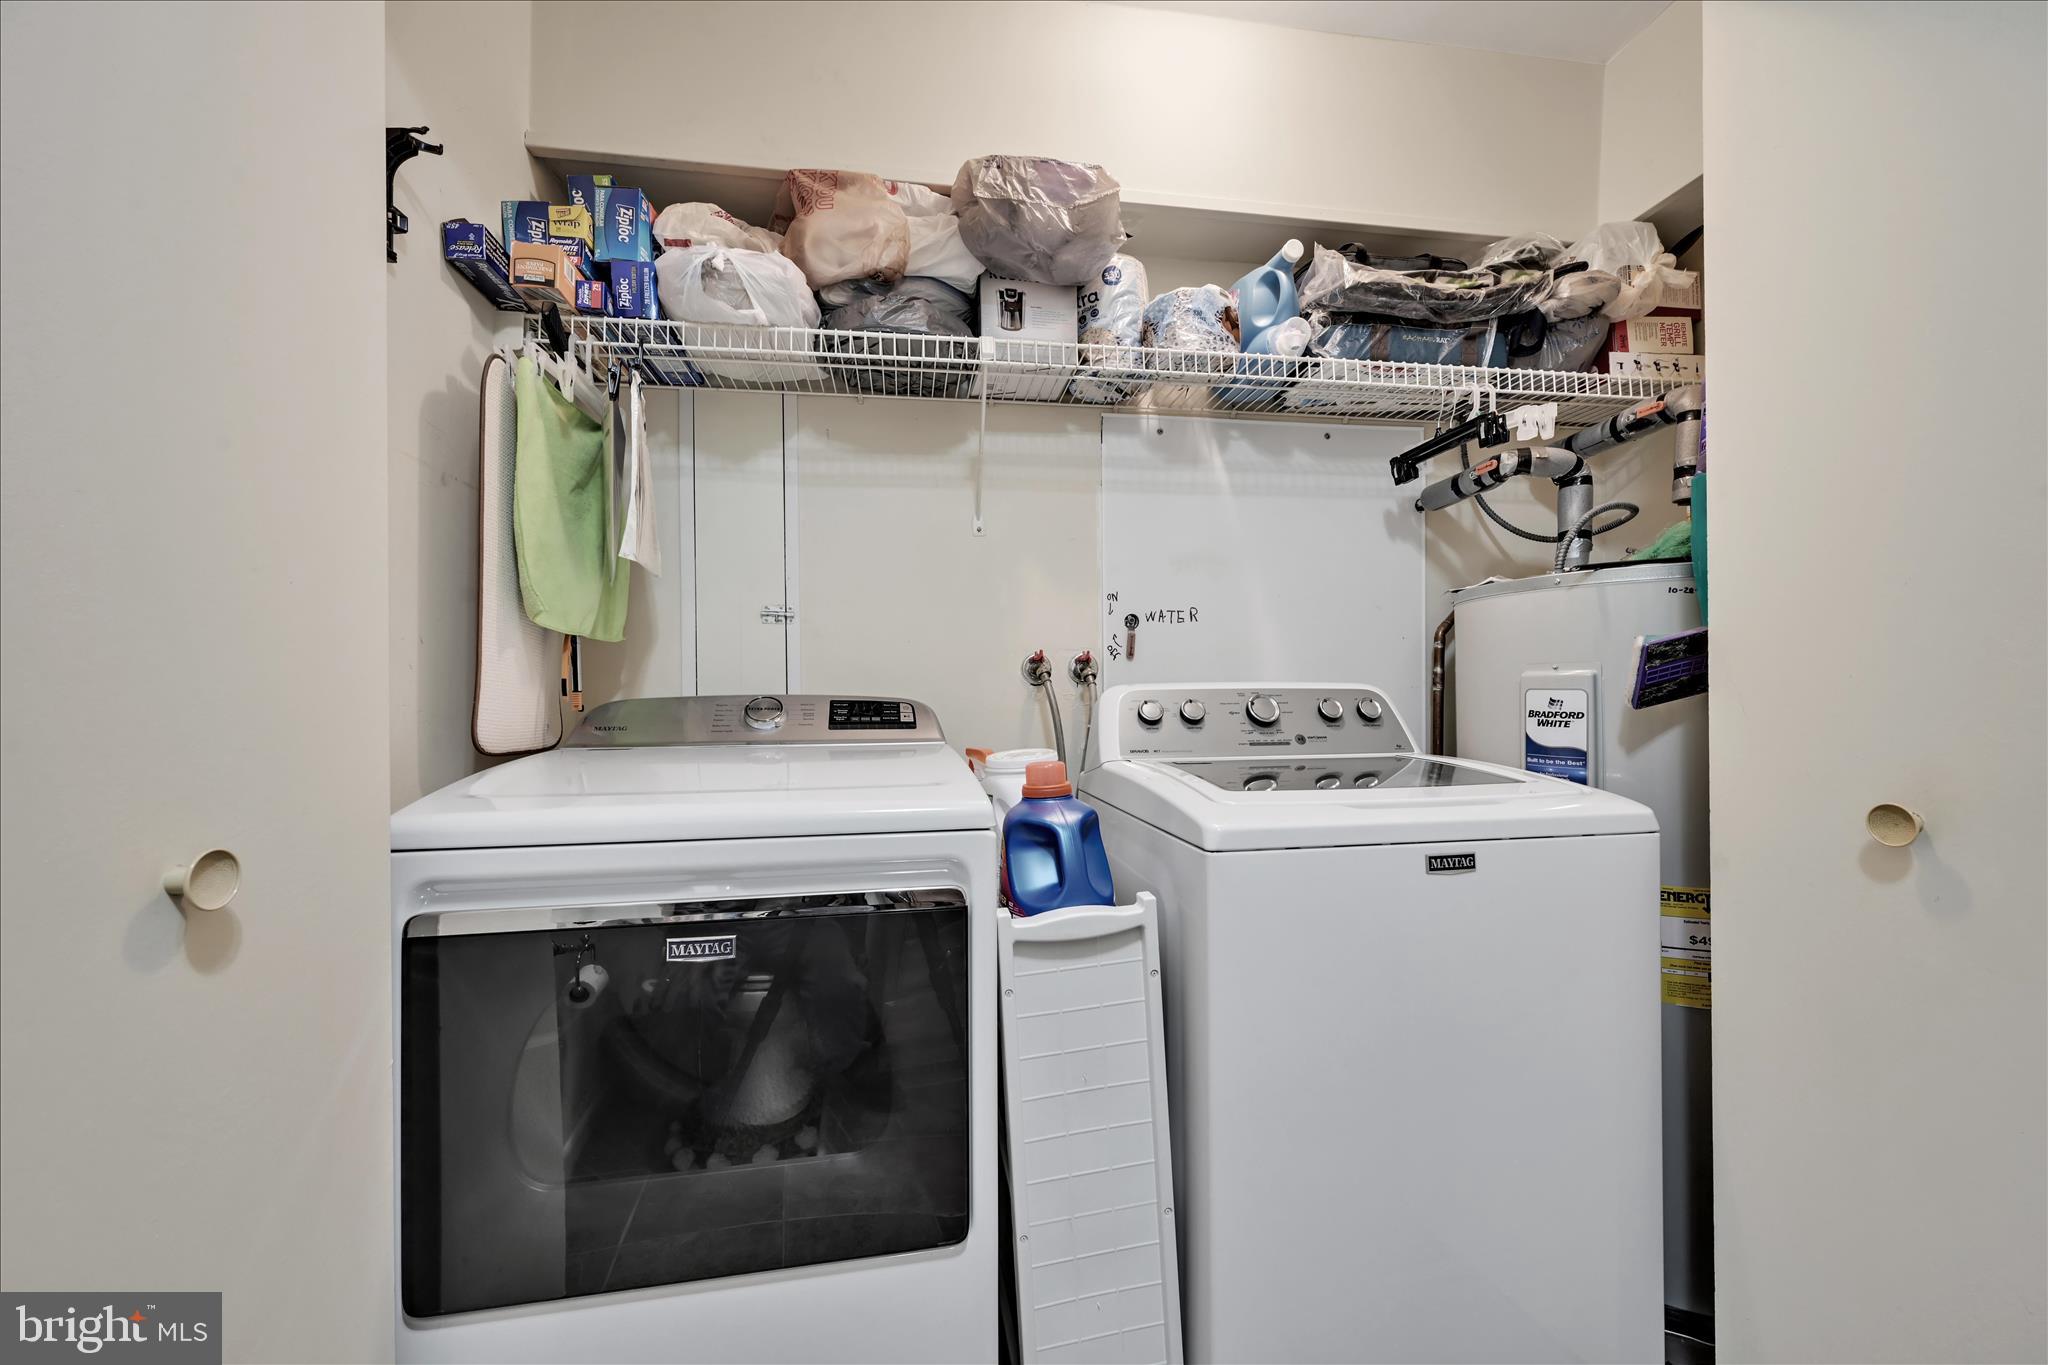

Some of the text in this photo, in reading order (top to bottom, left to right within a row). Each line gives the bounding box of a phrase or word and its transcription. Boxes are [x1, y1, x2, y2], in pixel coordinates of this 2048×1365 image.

[616, 207, 633, 243] Ziploc
[449, 244, 483, 253] Release
[619, 278, 632, 307] Ziploc
[1077, 290, 1100, 309] tra
[1659, 322, 1667, 347] METER
[1673, 322, 1682, 347] GRILL
[1106, 591, 1119, 601] ON
[1145, 607, 1199, 624] WATER
[1528, 710, 1585, 720] BRADFORD
[1537, 719, 1571, 728] WHITE
[1430, 856, 1474, 869] MAYTAG
[670, 941, 732, 957] MAYTAG
